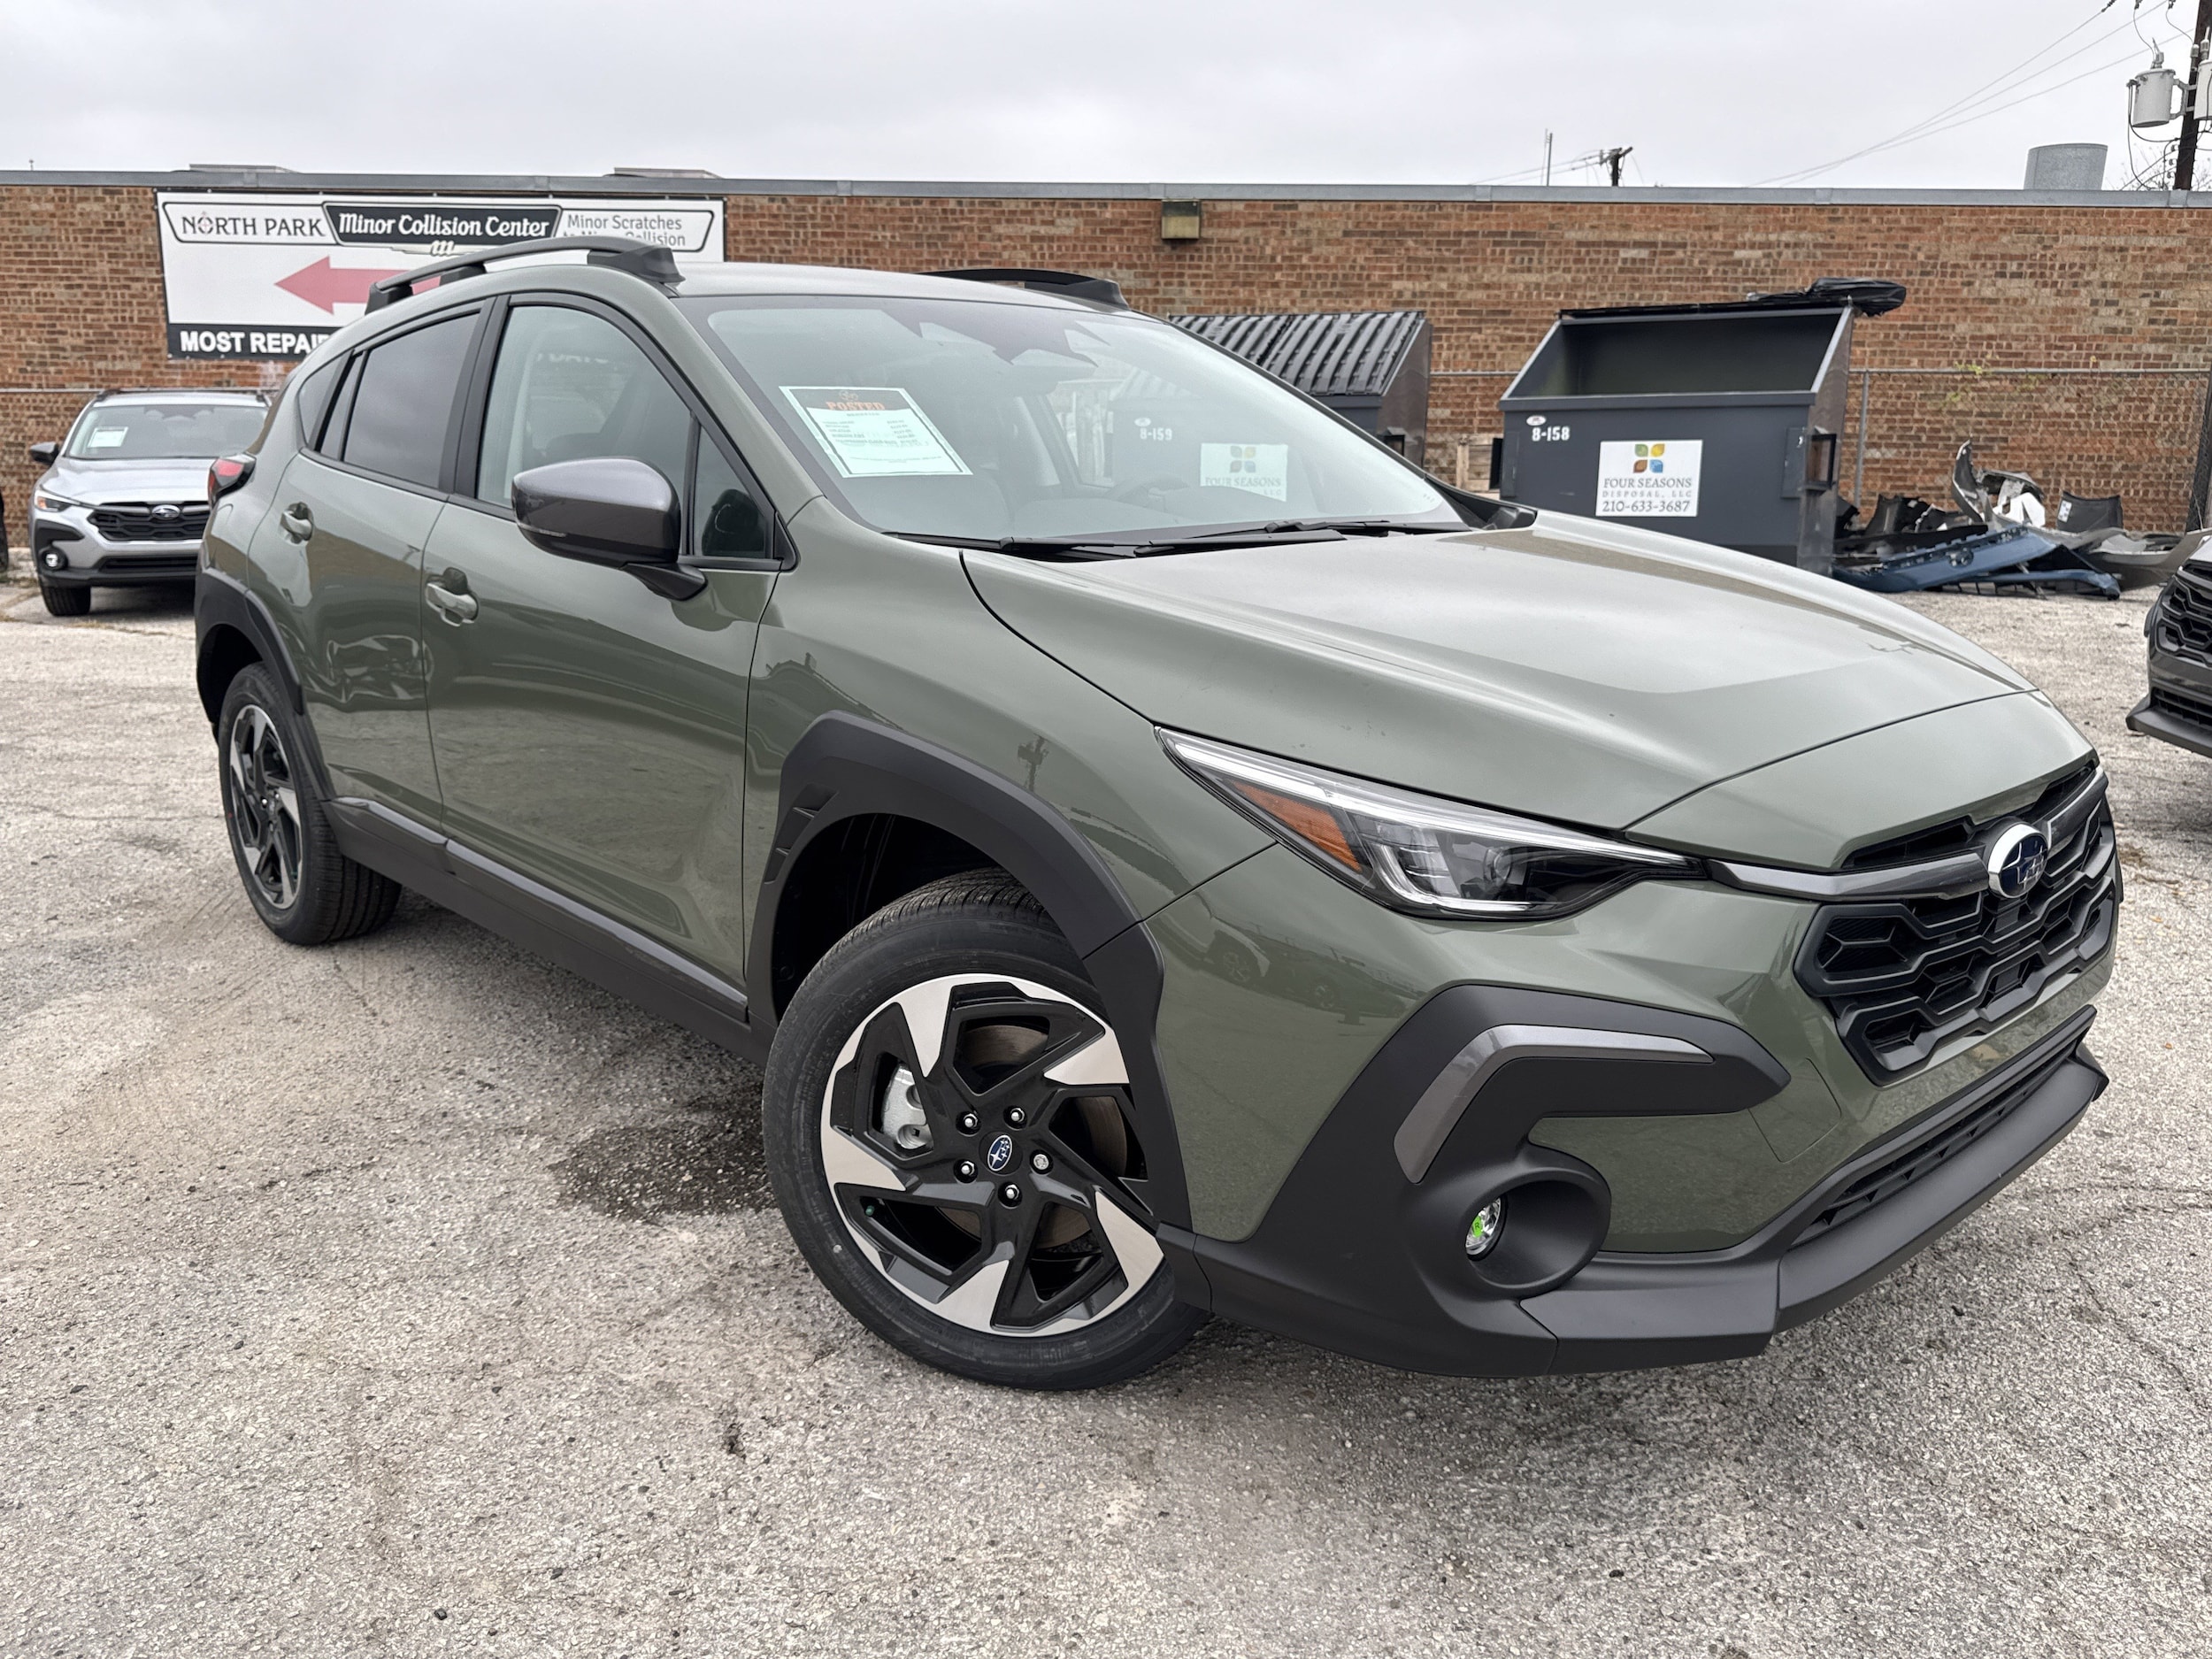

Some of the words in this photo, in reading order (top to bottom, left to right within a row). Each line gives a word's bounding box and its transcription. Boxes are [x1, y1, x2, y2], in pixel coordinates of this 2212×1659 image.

[182, 215, 257, 235] NORTH
[265, 218, 326, 236] PARK
[339, 211, 396, 234] Minor
[398, 213, 482, 236] Collision
[485, 216, 549, 237] Center
[567, 214, 609, 229] Minor
[612, 215, 682, 230] Scratches
[180, 330, 245, 353] MOST
[825, 401, 887, 411] POSTED
[1140, 426, 1173, 441] 8-159
[1532, 426, 1571, 442] 8-158
[1234, 477, 1281, 488] SEASONS
[1603, 478, 1635, 488] FOUR
[1637, 478, 1693, 488] SEASONS
[1602, 500, 1691, 512] 210-633-3687
